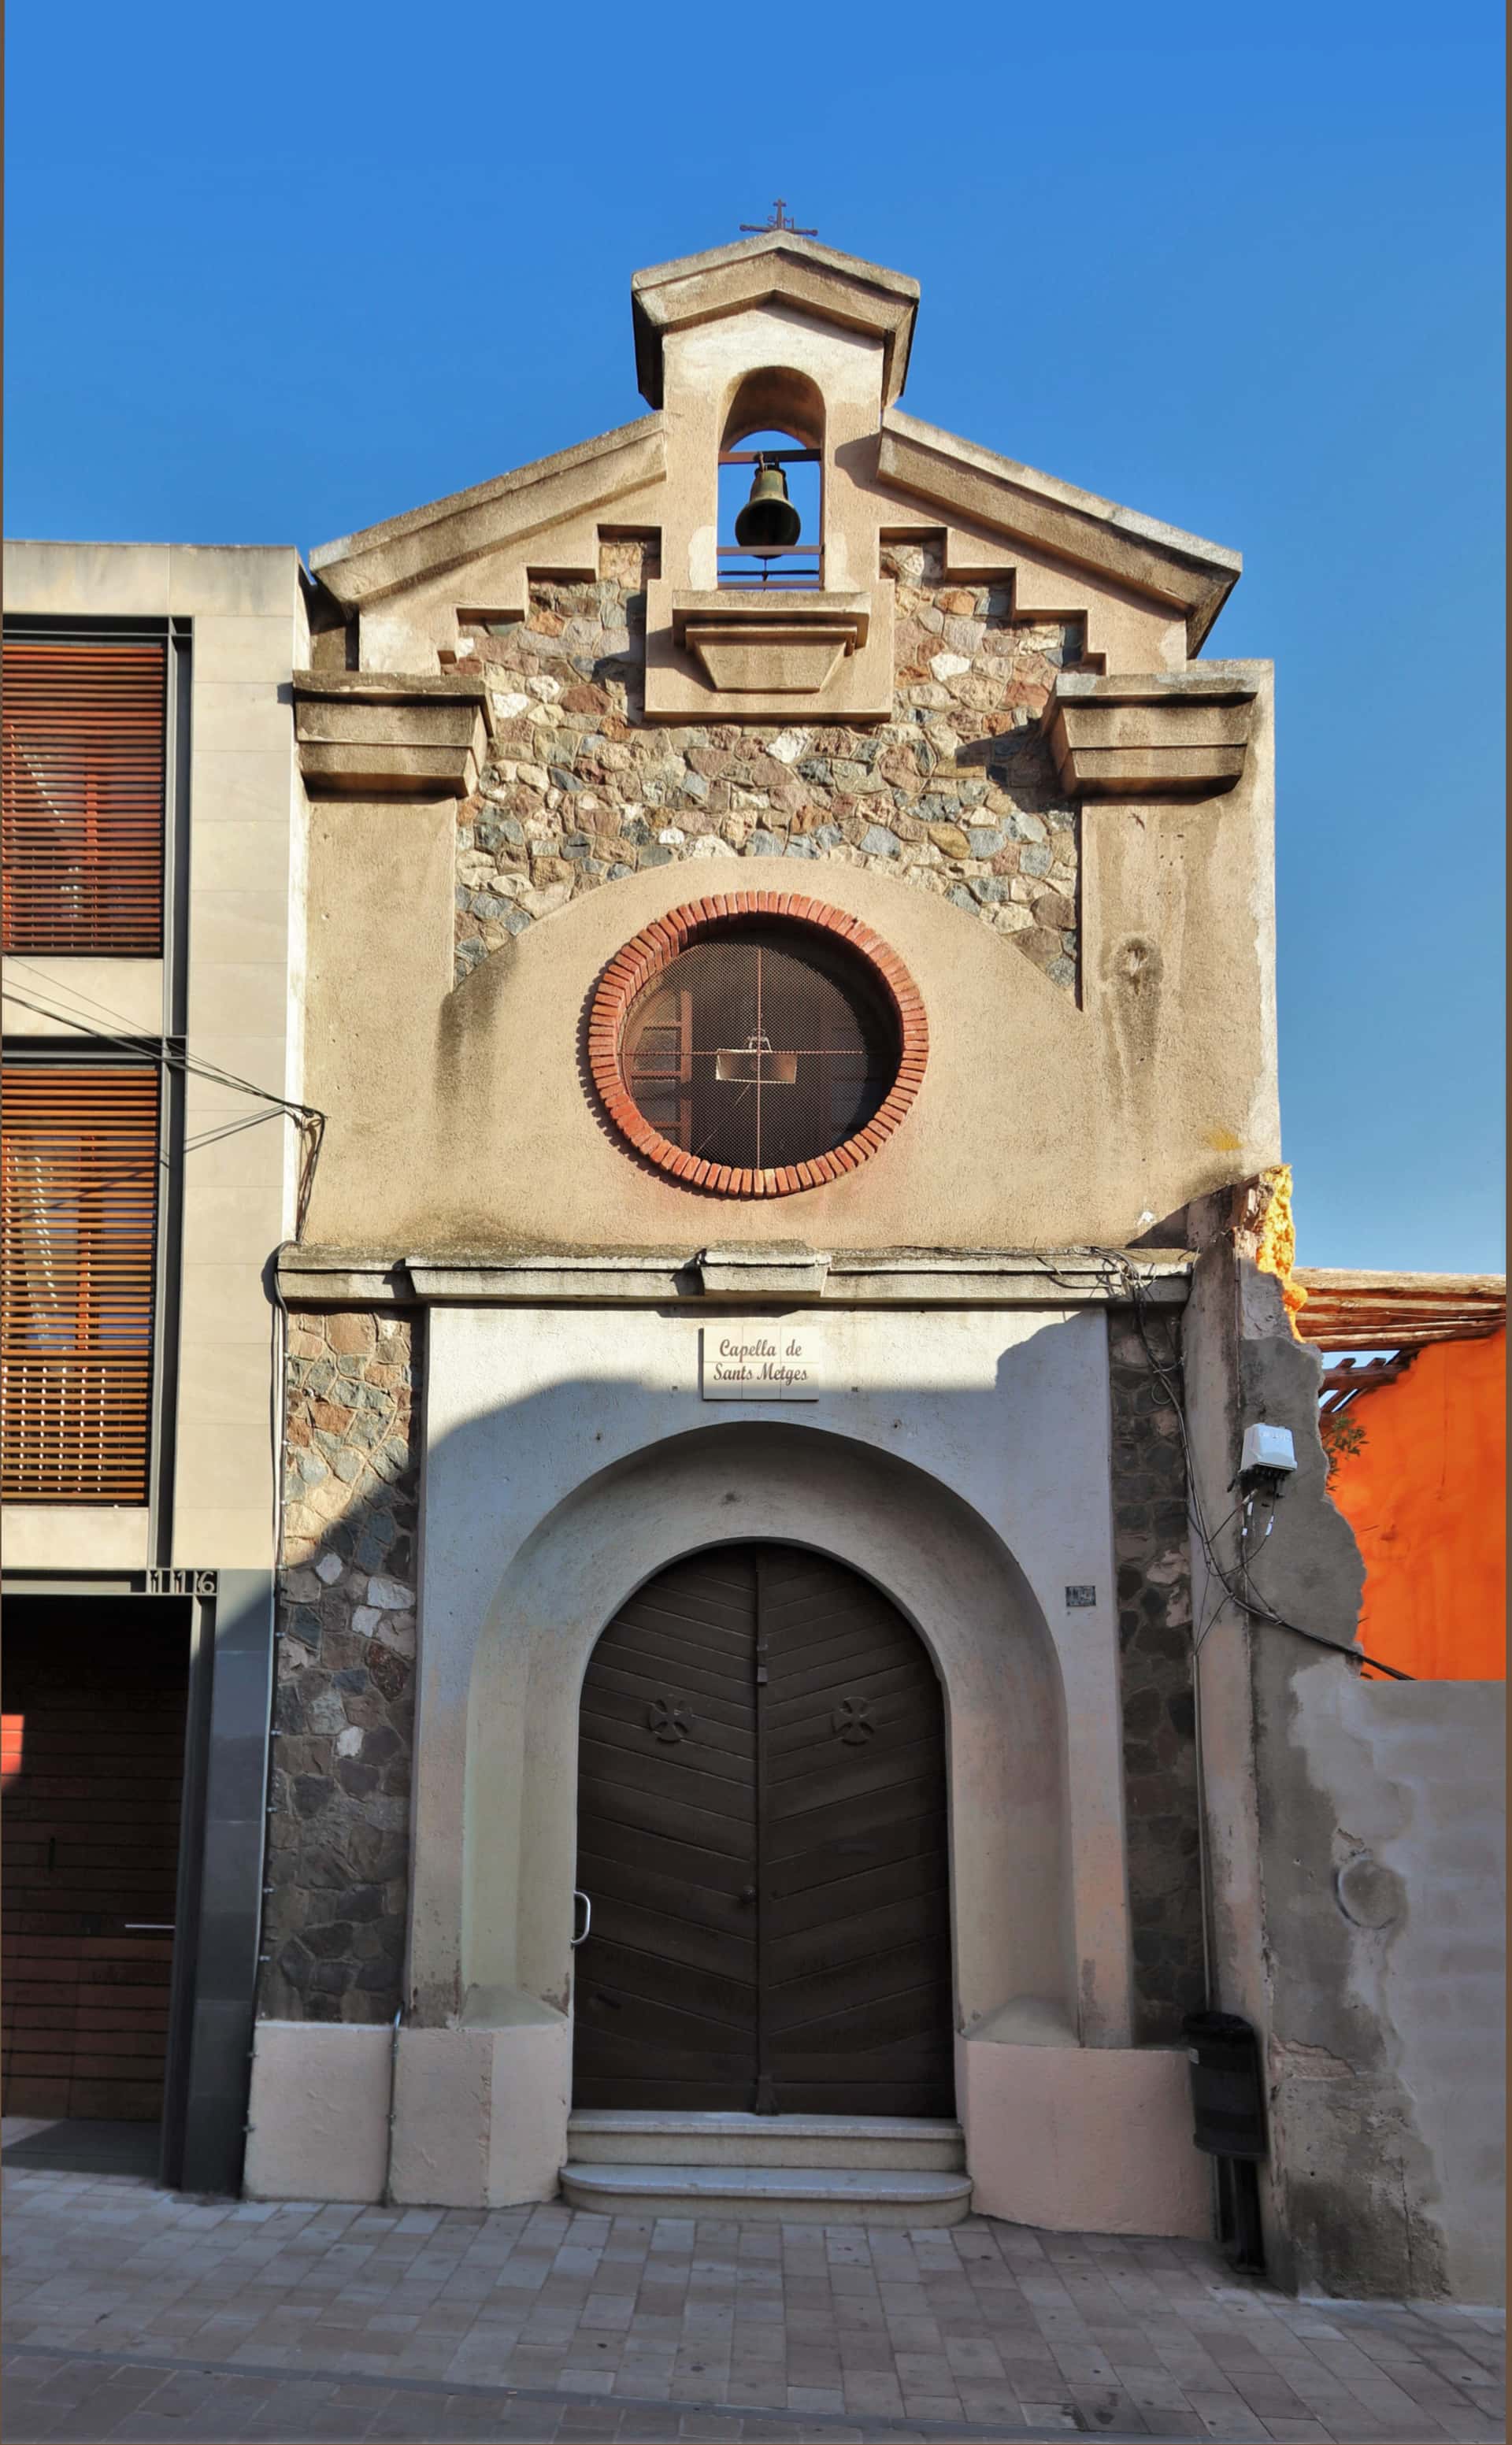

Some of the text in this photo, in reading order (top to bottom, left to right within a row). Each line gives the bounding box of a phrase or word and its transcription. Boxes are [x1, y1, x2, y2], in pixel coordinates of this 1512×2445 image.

[720, 1339, 802, 1363] Capella de
[713, 1362, 808, 1386] Sants Metges
[154, 1570, 216, 1594] 116
